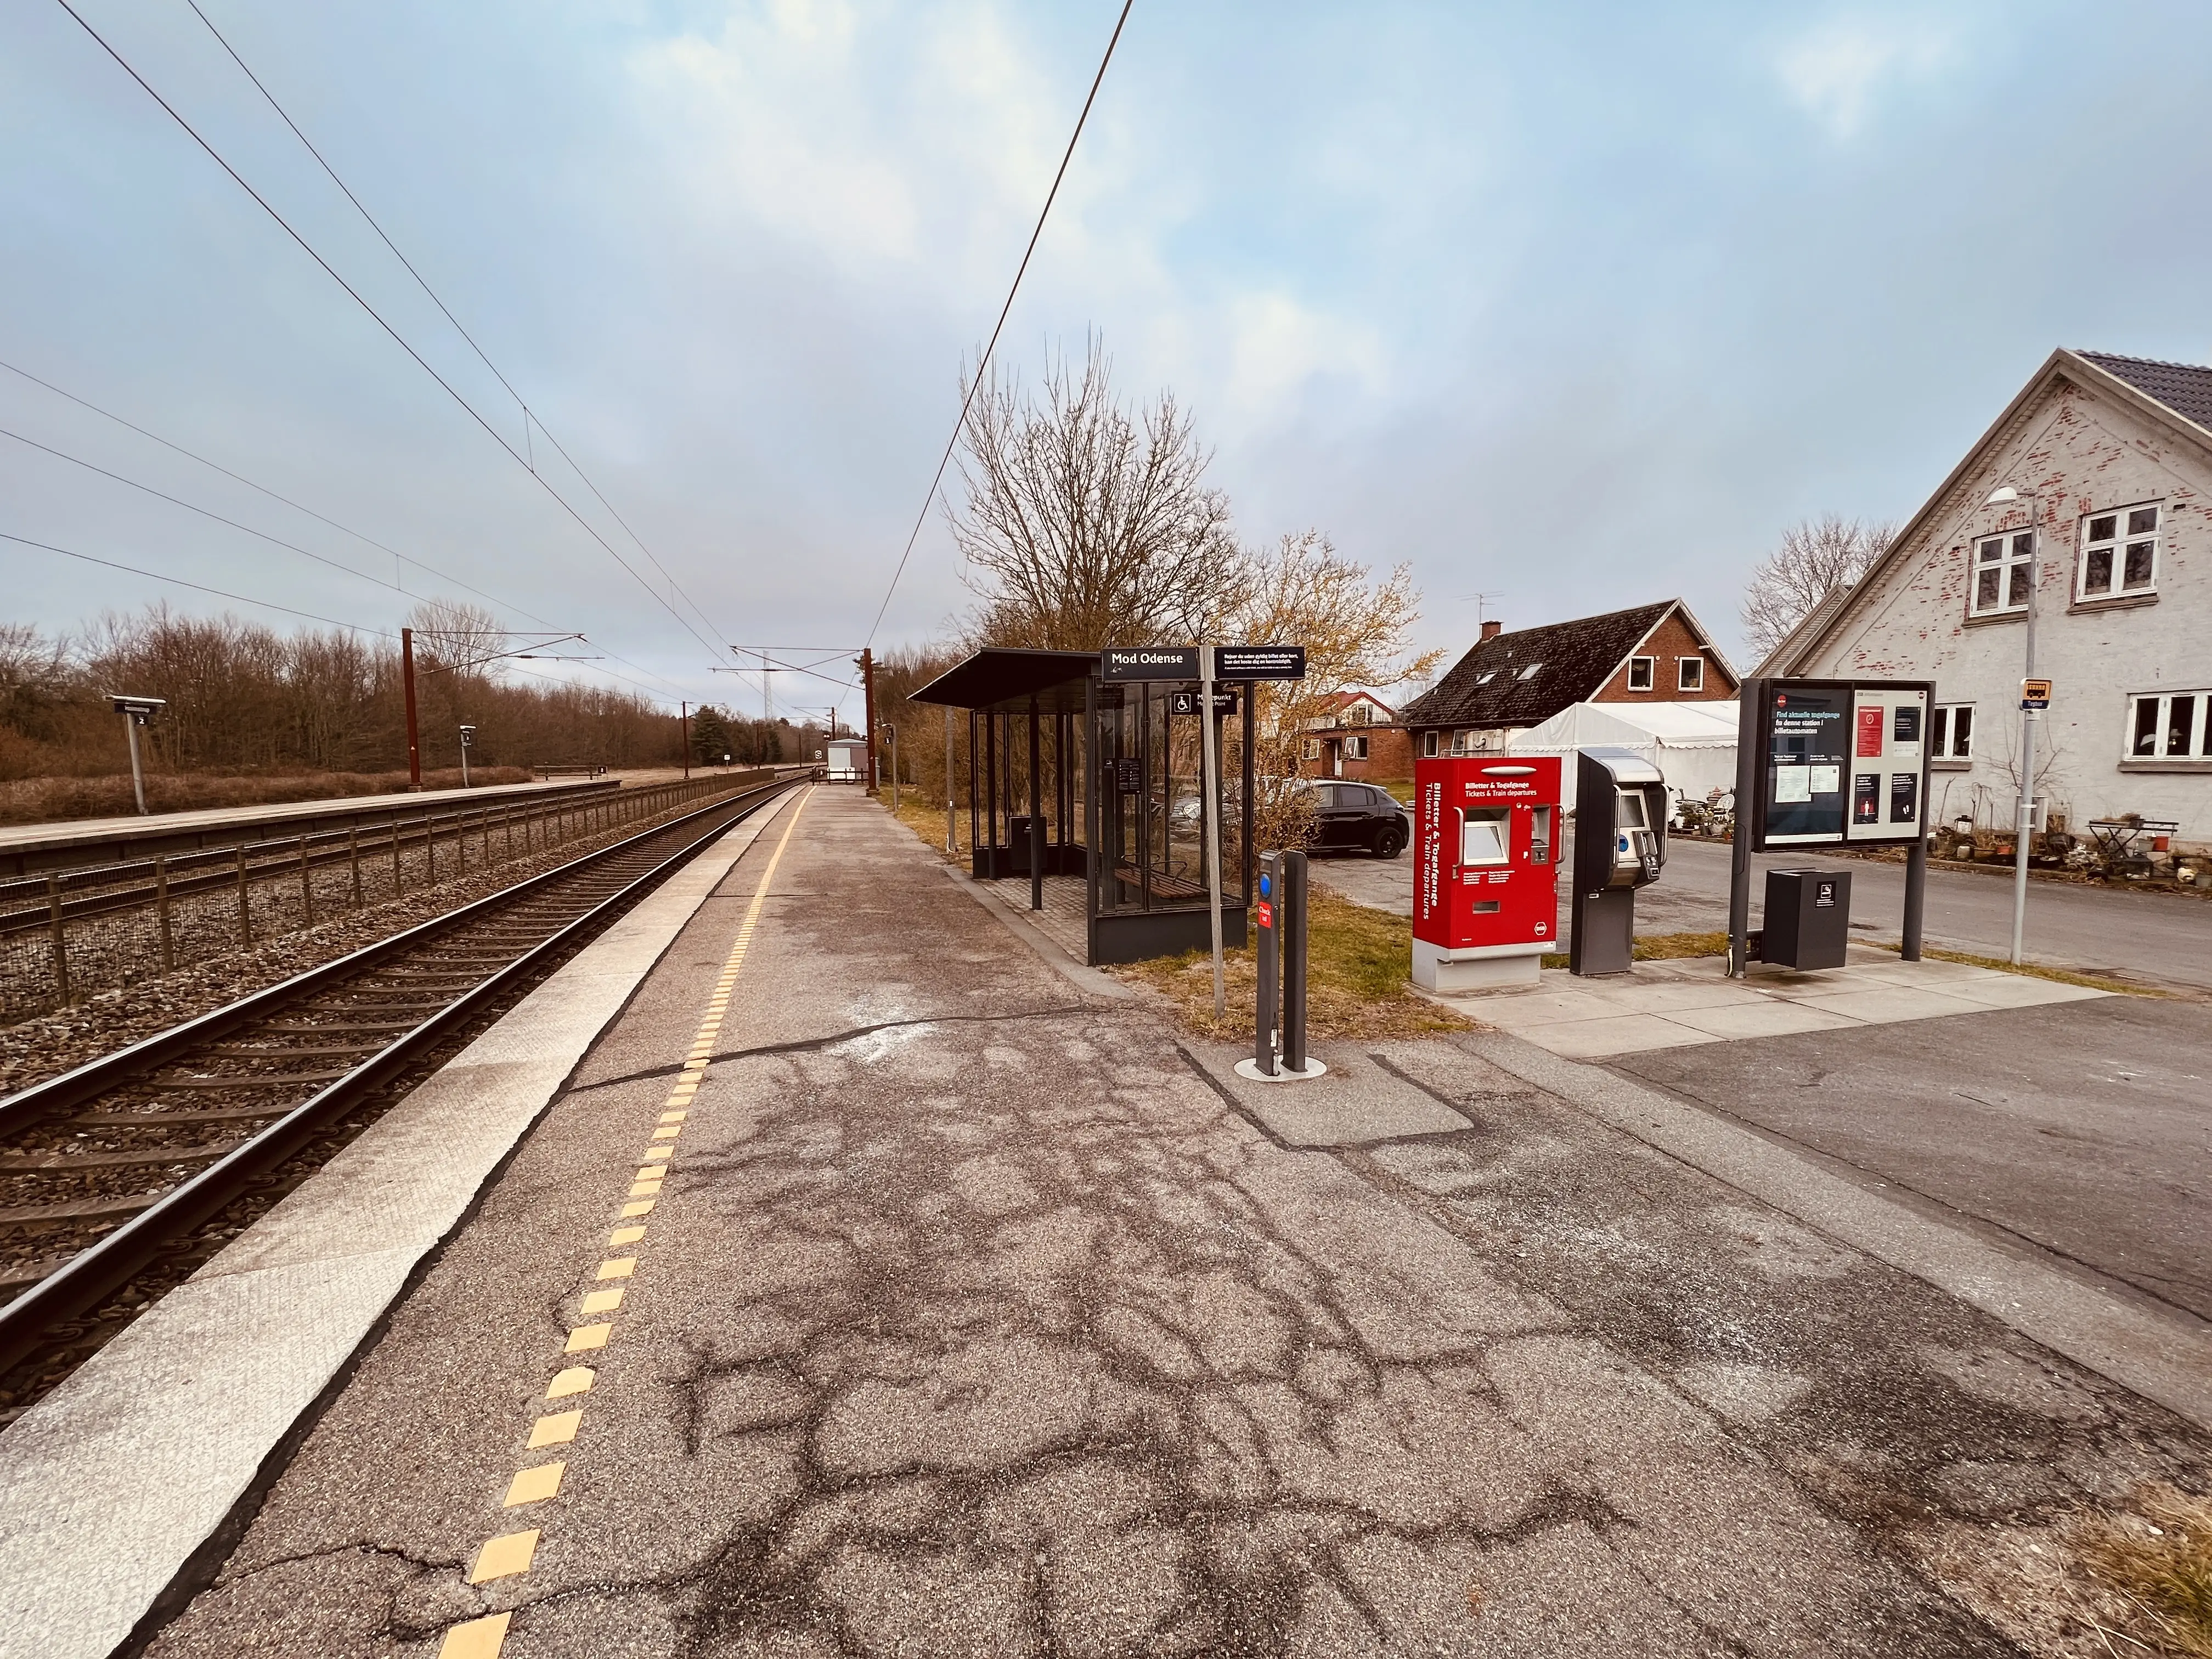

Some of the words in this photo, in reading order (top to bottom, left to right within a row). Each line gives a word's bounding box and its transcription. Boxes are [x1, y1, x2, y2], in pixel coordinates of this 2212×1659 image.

[1111, 653, 1137, 664] Mod
[1140, 653, 1183, 664] Odense
[1433, 782, 1441, 828] Billetter
[1433, 831, 1440, 839] &
[1423, 863, 1431, 919] departures
[1431, 842, 1440, 906] Togafgange
